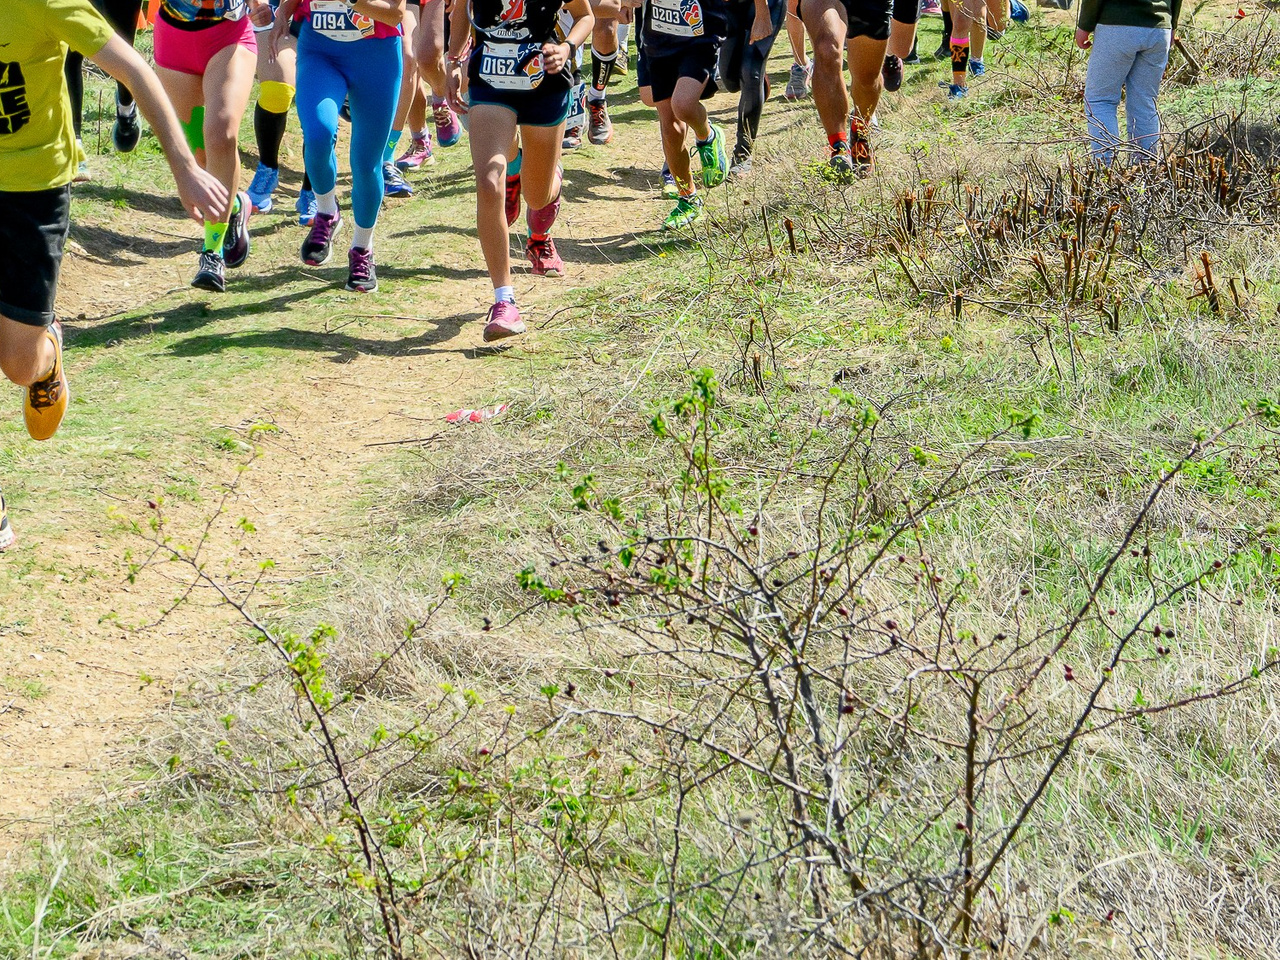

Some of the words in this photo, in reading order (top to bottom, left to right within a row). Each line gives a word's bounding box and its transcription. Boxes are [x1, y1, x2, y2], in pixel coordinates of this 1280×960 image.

[312, 14, 346, 30] 0194
[652, 6, 680, 24] 0203
[482, 57, 515, 75] 0162
